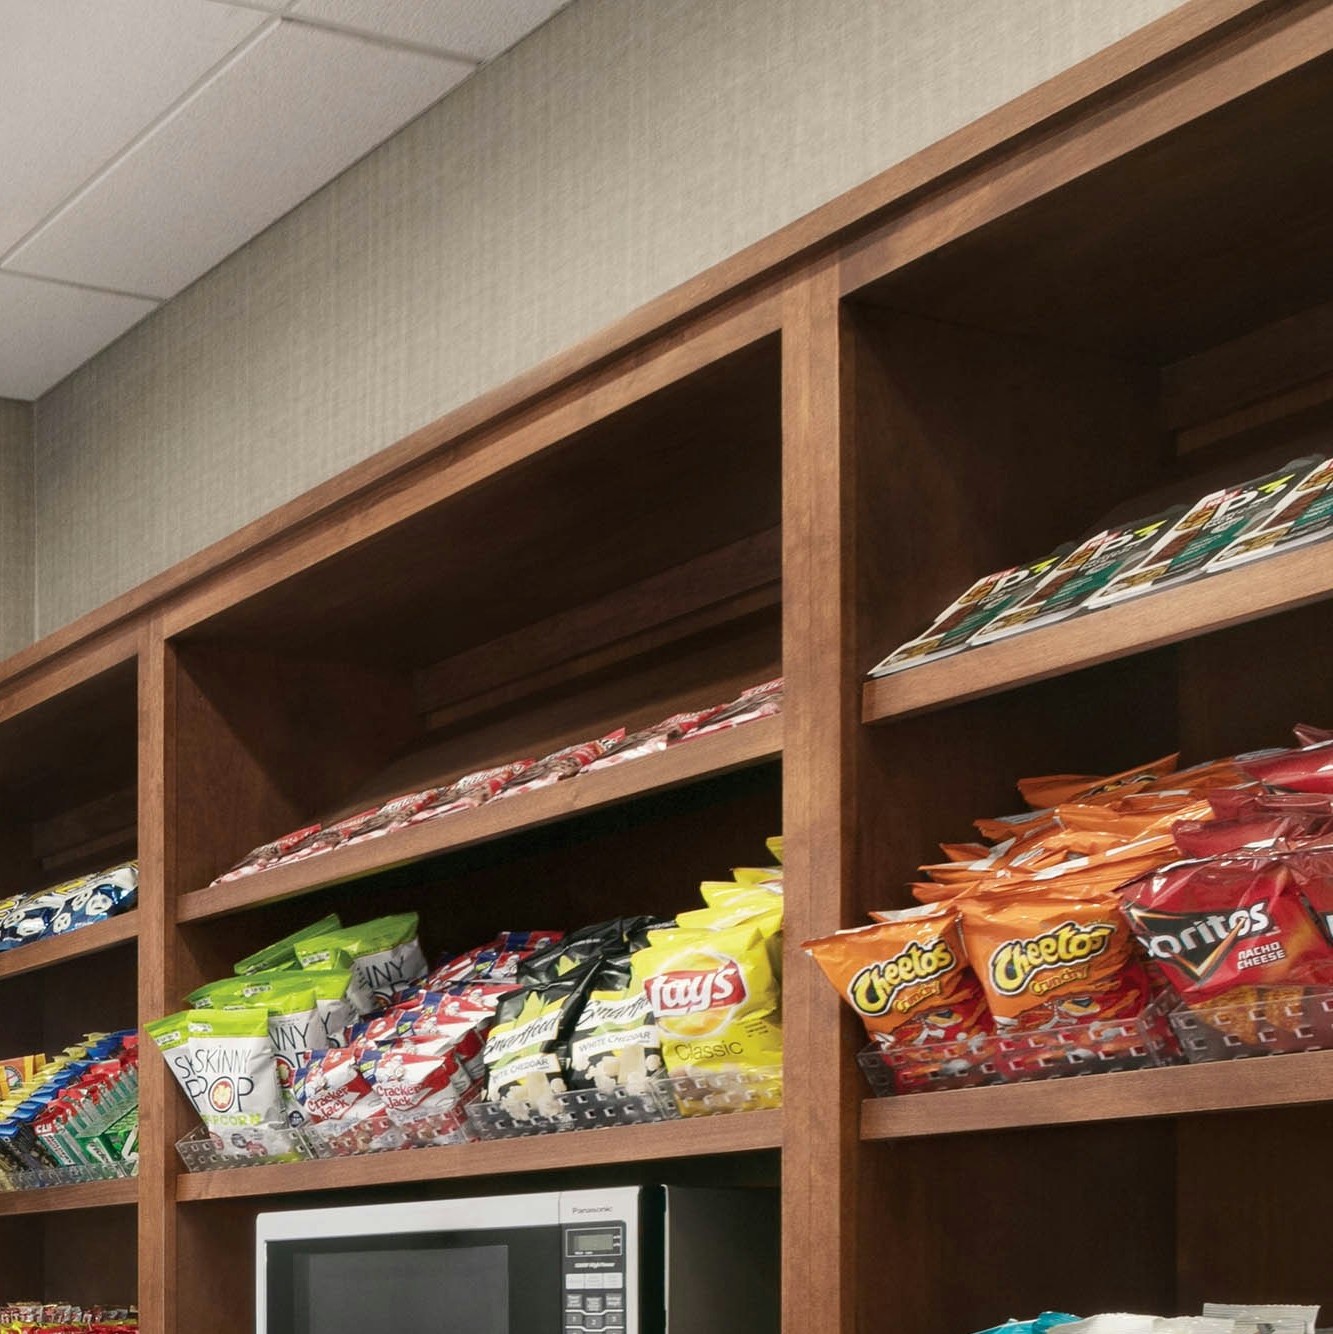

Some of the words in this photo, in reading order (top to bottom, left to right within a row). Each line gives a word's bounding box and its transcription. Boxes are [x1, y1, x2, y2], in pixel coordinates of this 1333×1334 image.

[990, 923, 1116, 993] Cheetos
[1236, 951, 1286, 970] CHEESE
[1237, 941, 1281, 961] NACHO
[851, 940, 954, 1014] Cheetos
[1031, 965, 1091, 996] Crunchy
[651, 966, 737, 1014] Lay's
[893, 979, 942, 1013] Crunchy
[607, 1031, 651, 1043] CHEDDAR
[195, 1045, 252, 1074] SKINNY
[674, 1039, 744, 1061] Classic
[307, 1086, 349, 1112] Cracker
[376, 1084, 422, 1097] Cracker
[321, 1099, 351, 1121] Jack
[387, 1096, 413, 1109] Jack
[572, 1206, 613, 1214] Panasonic
